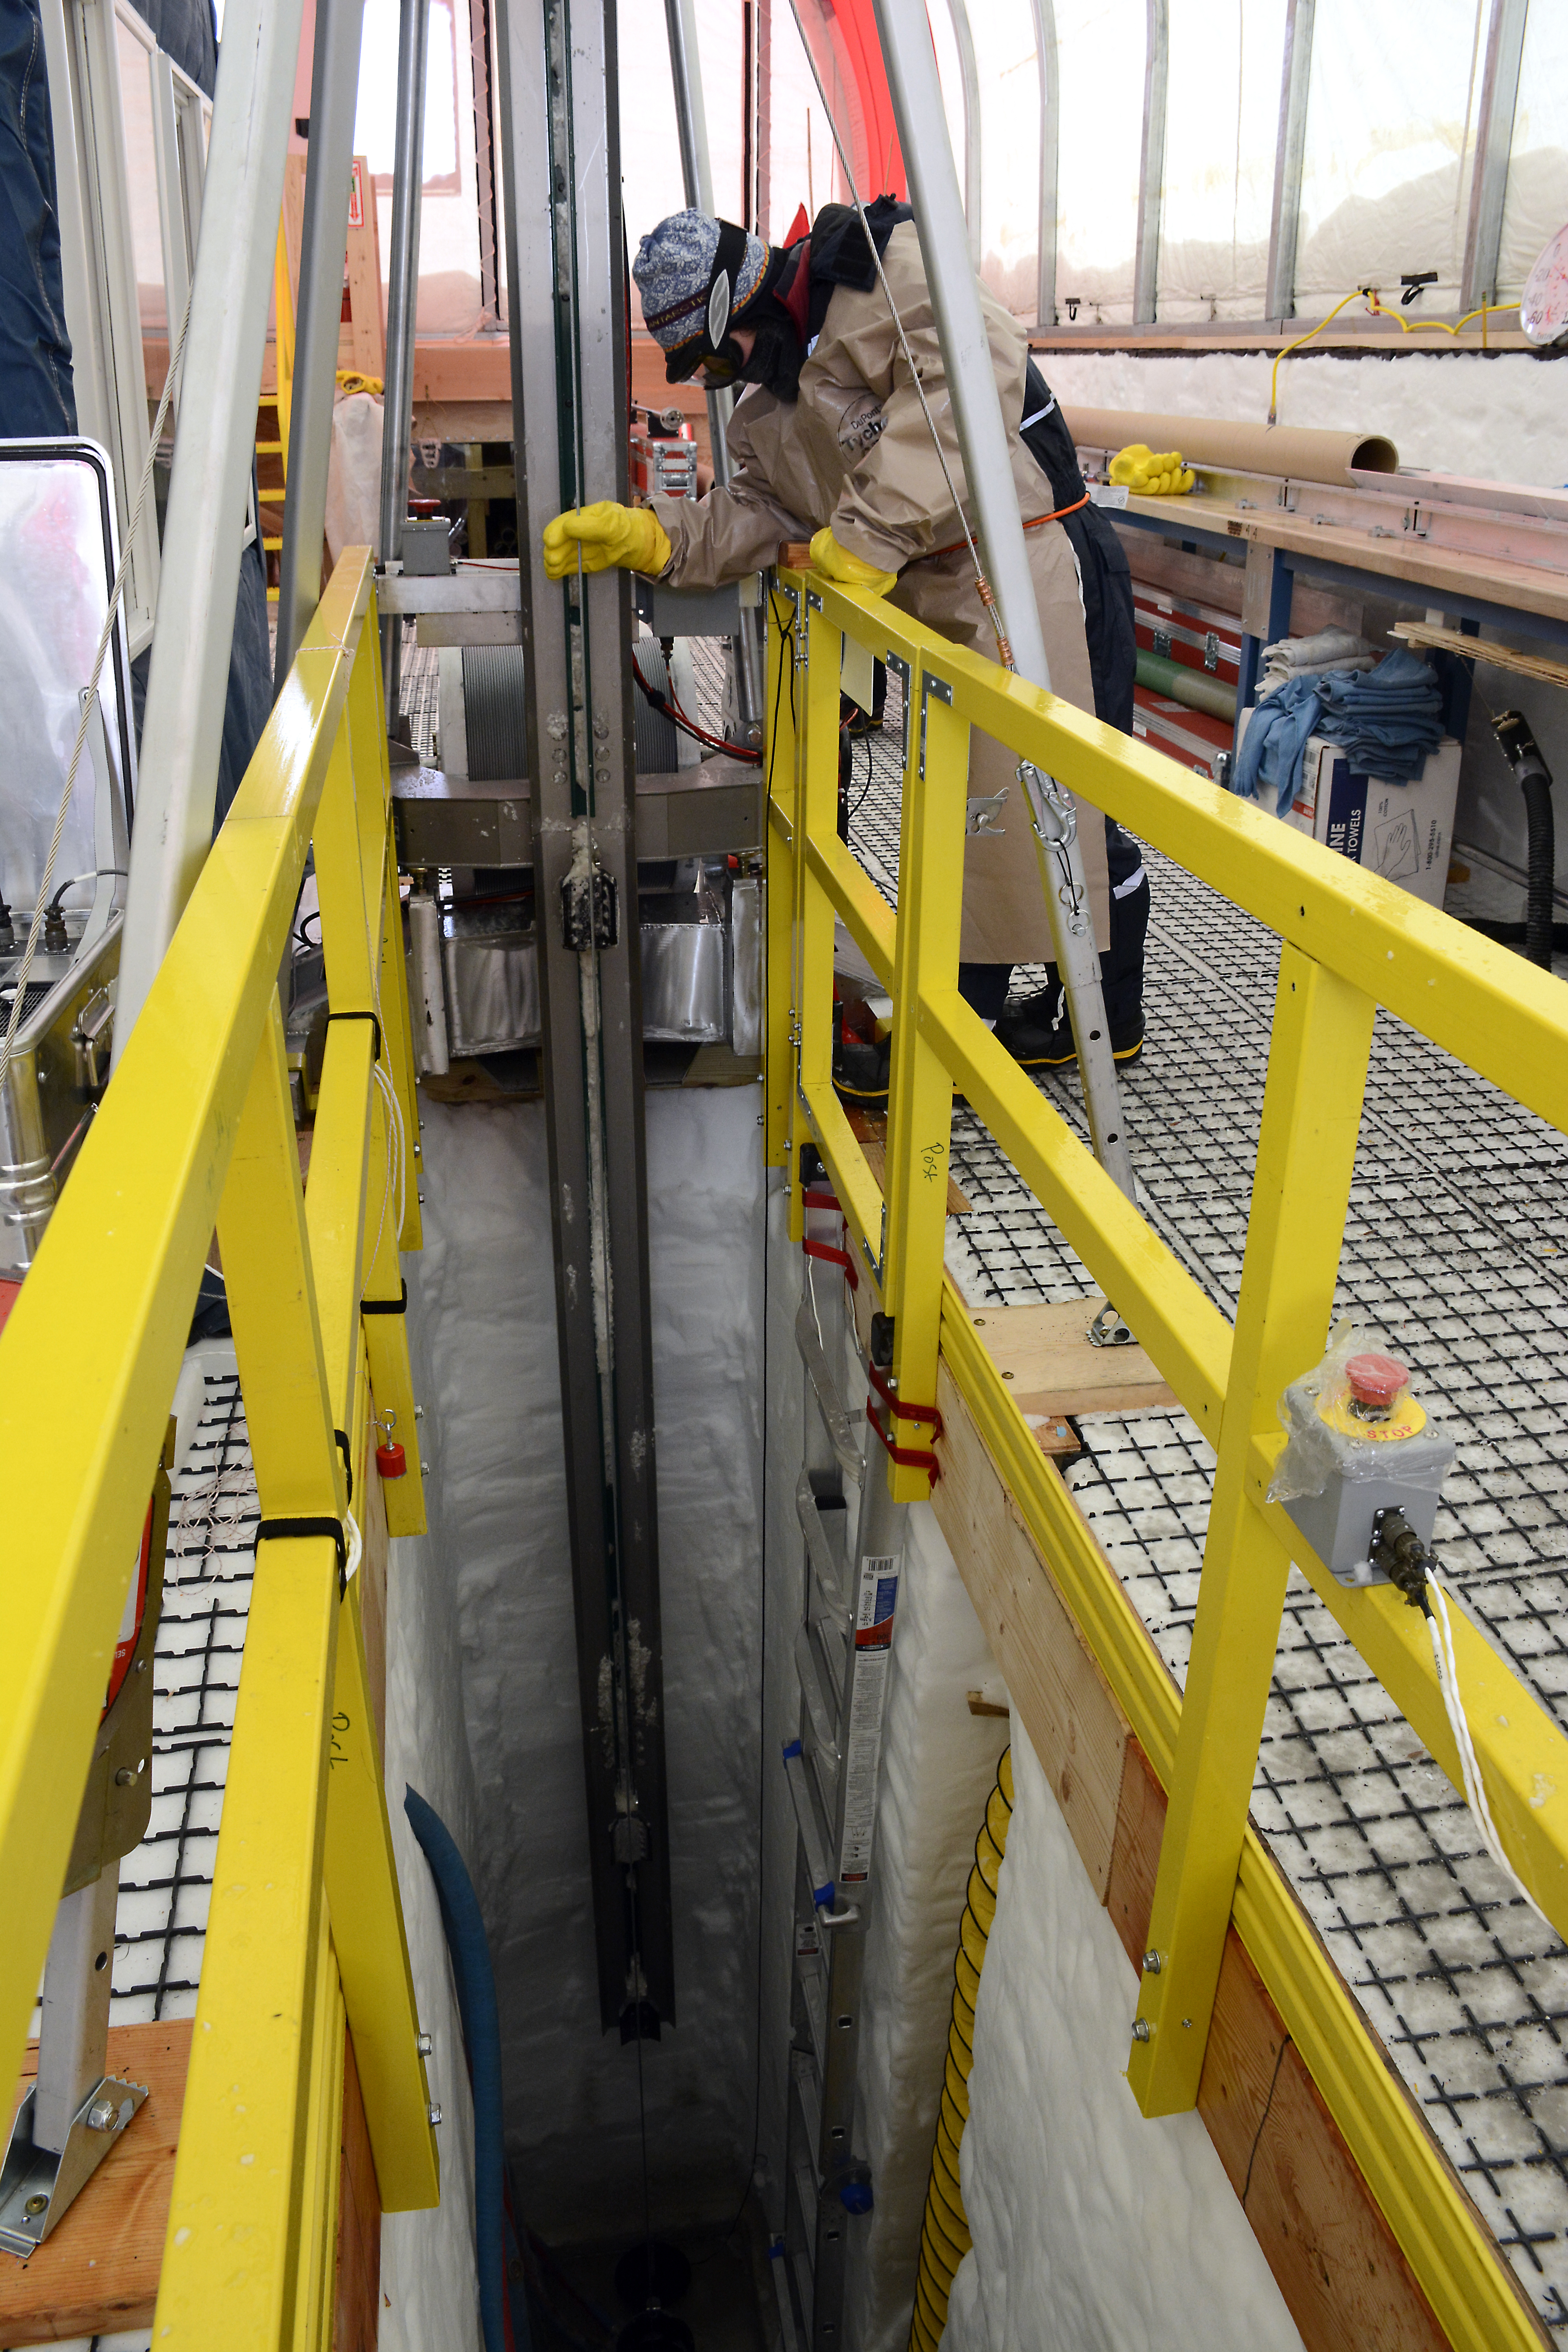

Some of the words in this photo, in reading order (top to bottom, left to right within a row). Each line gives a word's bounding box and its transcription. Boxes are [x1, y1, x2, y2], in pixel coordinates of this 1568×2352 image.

[1553, 243, 1561, 258] 0
[1527, 311, 1543, 325] -60
[1347, 809, 1361, 853] TOWELS
[1426, 820, 1437, 870] 1-800-295-5510
[921, 1142, 944, 1182] Post
[1367, 1426, 1412, 1438] STOP
